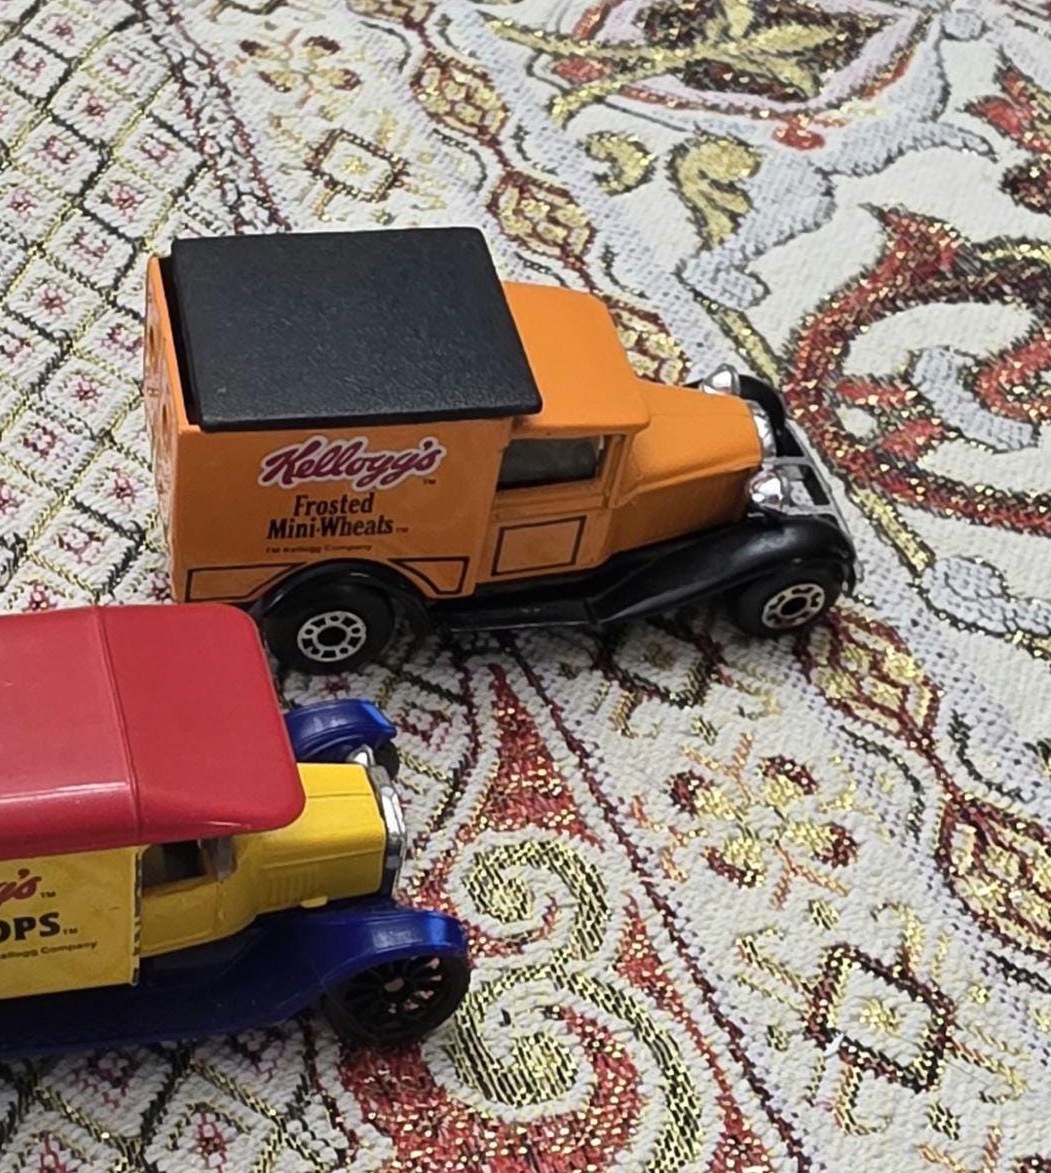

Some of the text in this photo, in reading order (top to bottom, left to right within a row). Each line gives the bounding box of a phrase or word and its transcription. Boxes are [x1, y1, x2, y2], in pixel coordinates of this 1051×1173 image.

[260, 438, 443, 489] Kellogg's
[293, 492, 376, 517] Frosted
[40, 940, 98, 954] Company
